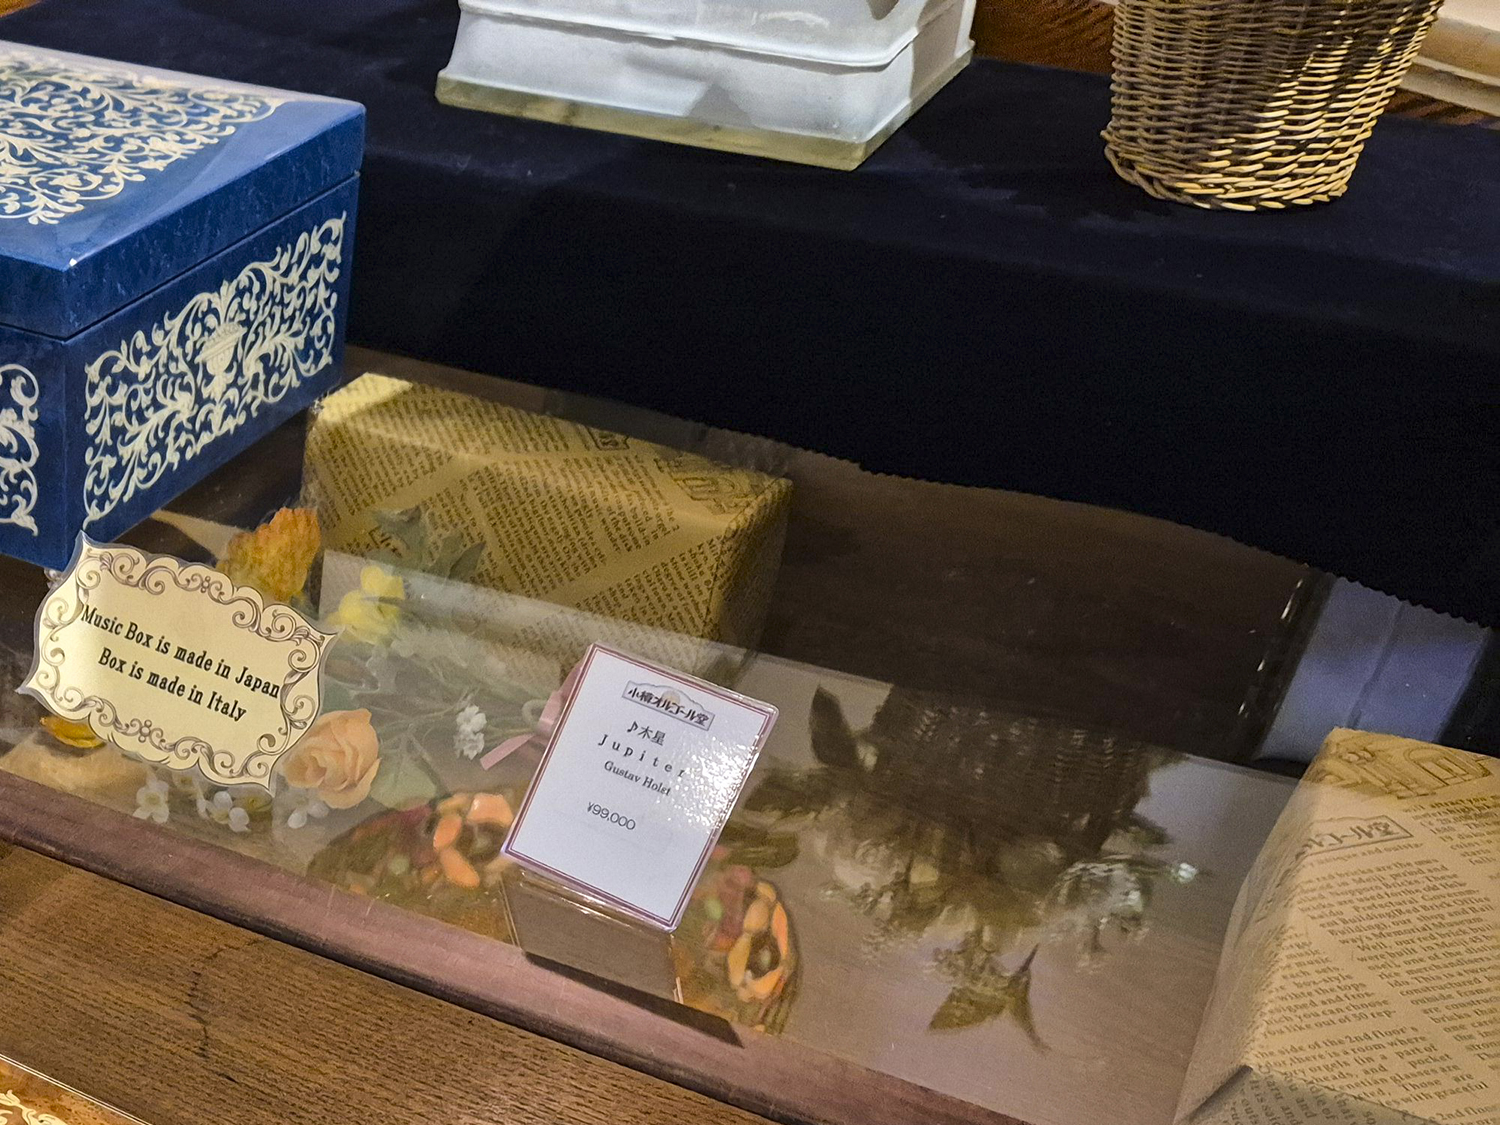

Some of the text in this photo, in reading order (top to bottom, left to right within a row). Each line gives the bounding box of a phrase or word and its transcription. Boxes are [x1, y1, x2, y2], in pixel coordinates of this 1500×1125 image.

[81, 604, 280, 699] Music Box is made in Japan
[98, 647, 248, 722] Box is made in Italy
[627, 687, 710, 727] 小樽オルゴール堂
[604, 760, 672, 796] Gustav Holst
[587, 801, 636, 830] ¥99,000
